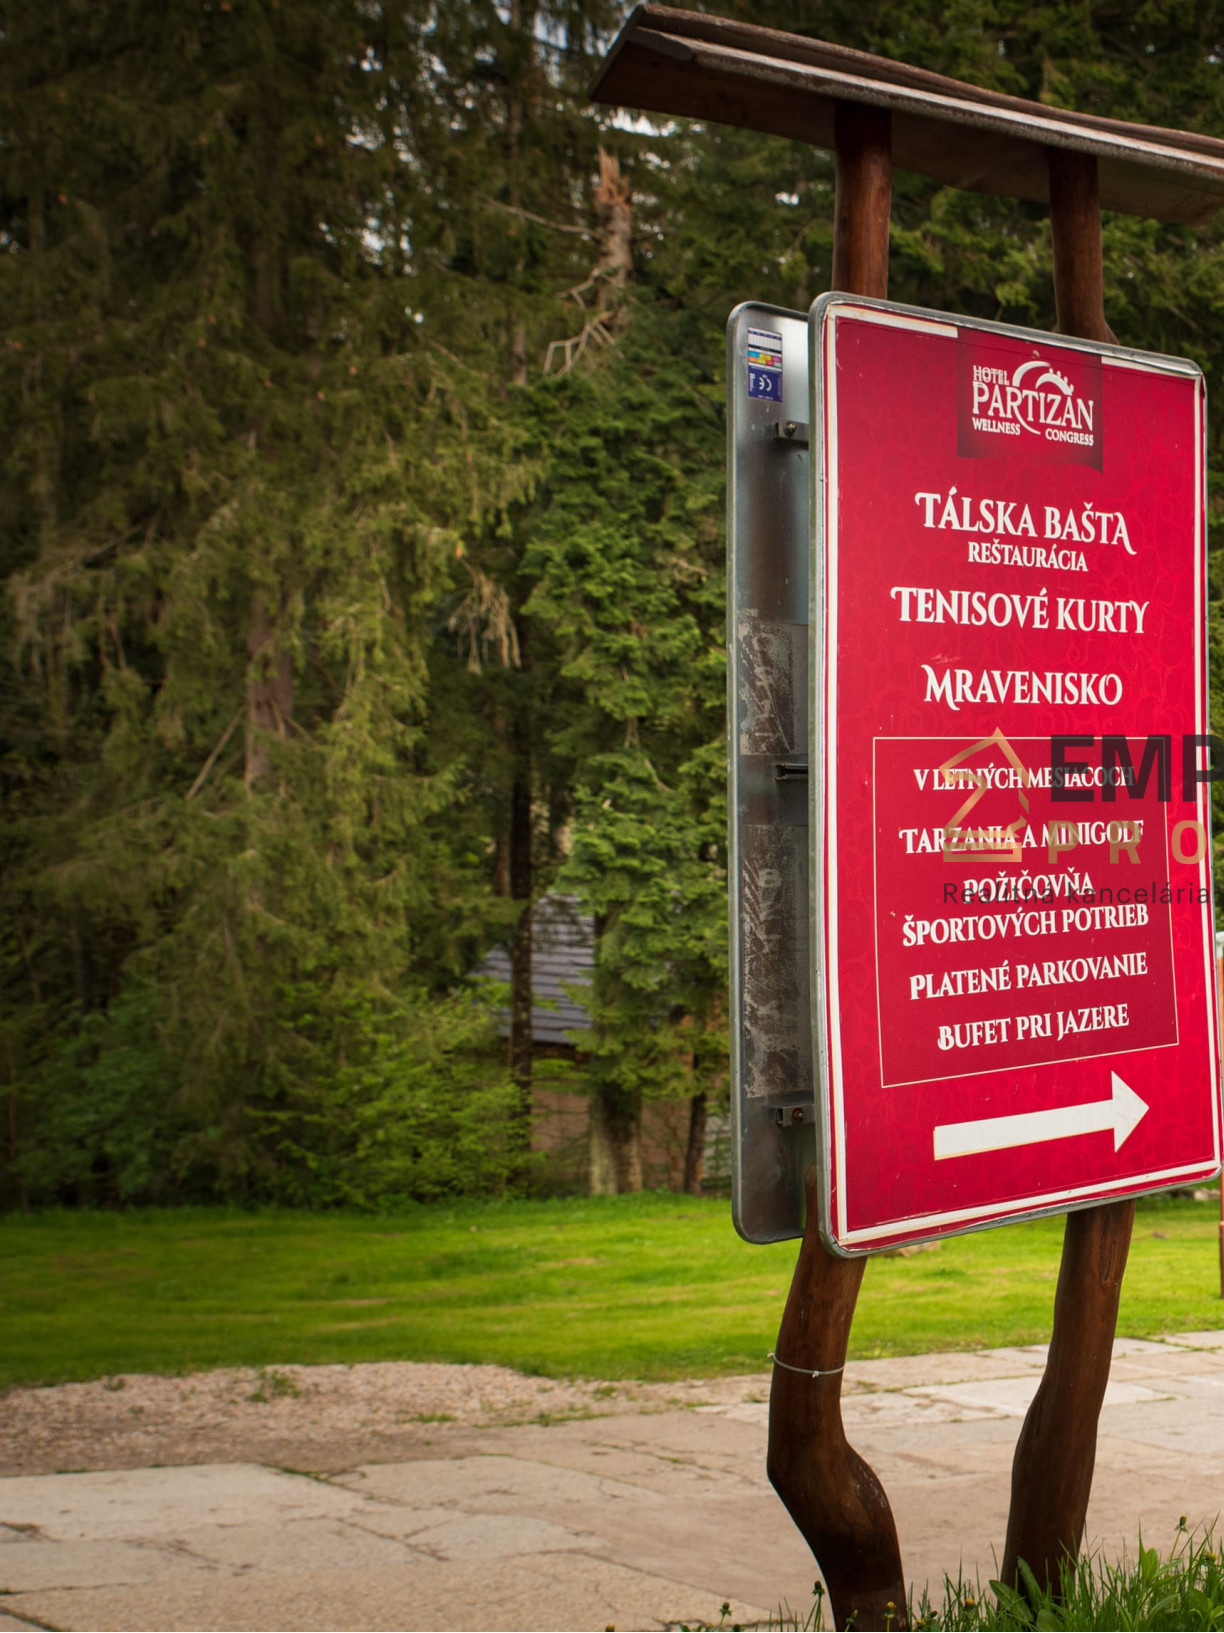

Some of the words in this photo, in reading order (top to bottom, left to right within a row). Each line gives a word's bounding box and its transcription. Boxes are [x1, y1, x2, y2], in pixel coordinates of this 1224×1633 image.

[973, 365, 1009, 385] HOTEL
[972, 417, 1021, 435] WELLNESS
[1045, 428, 1094, 446] CONGRESS
[914, 486, 1038, 539] TÁLSKA
[1044, 502, 1137, 555] BAŠTA
[968, 540, 1088, 572] REŠTAURÁCIA
[890, 586, 1049, 629] TENISOVÉ
[1056, 598, 1150, 634] KURTY
[921, 665, 1123, 711] MRAVENISKO
[1022, 828, 1037, 848] A
[1041, 820, 1144, 847] MINIGOLF
[963, 867, 1095, 904] POŽIČOVŇA
[902, 907, 1057, 947] ŠPORTOVÝCH
[1062, 904, 1149, 930] POTRIEB
[909, 959, 1011, 1000] PLATENÉ
[1016, 952, 1148, 989] PARKOVANIE
[937, 1017, 1011, 1050] BUFET
[1016, 1012, 1052, 1040] PRI
[1057, 1004, 1129, 1041] JAZERE
